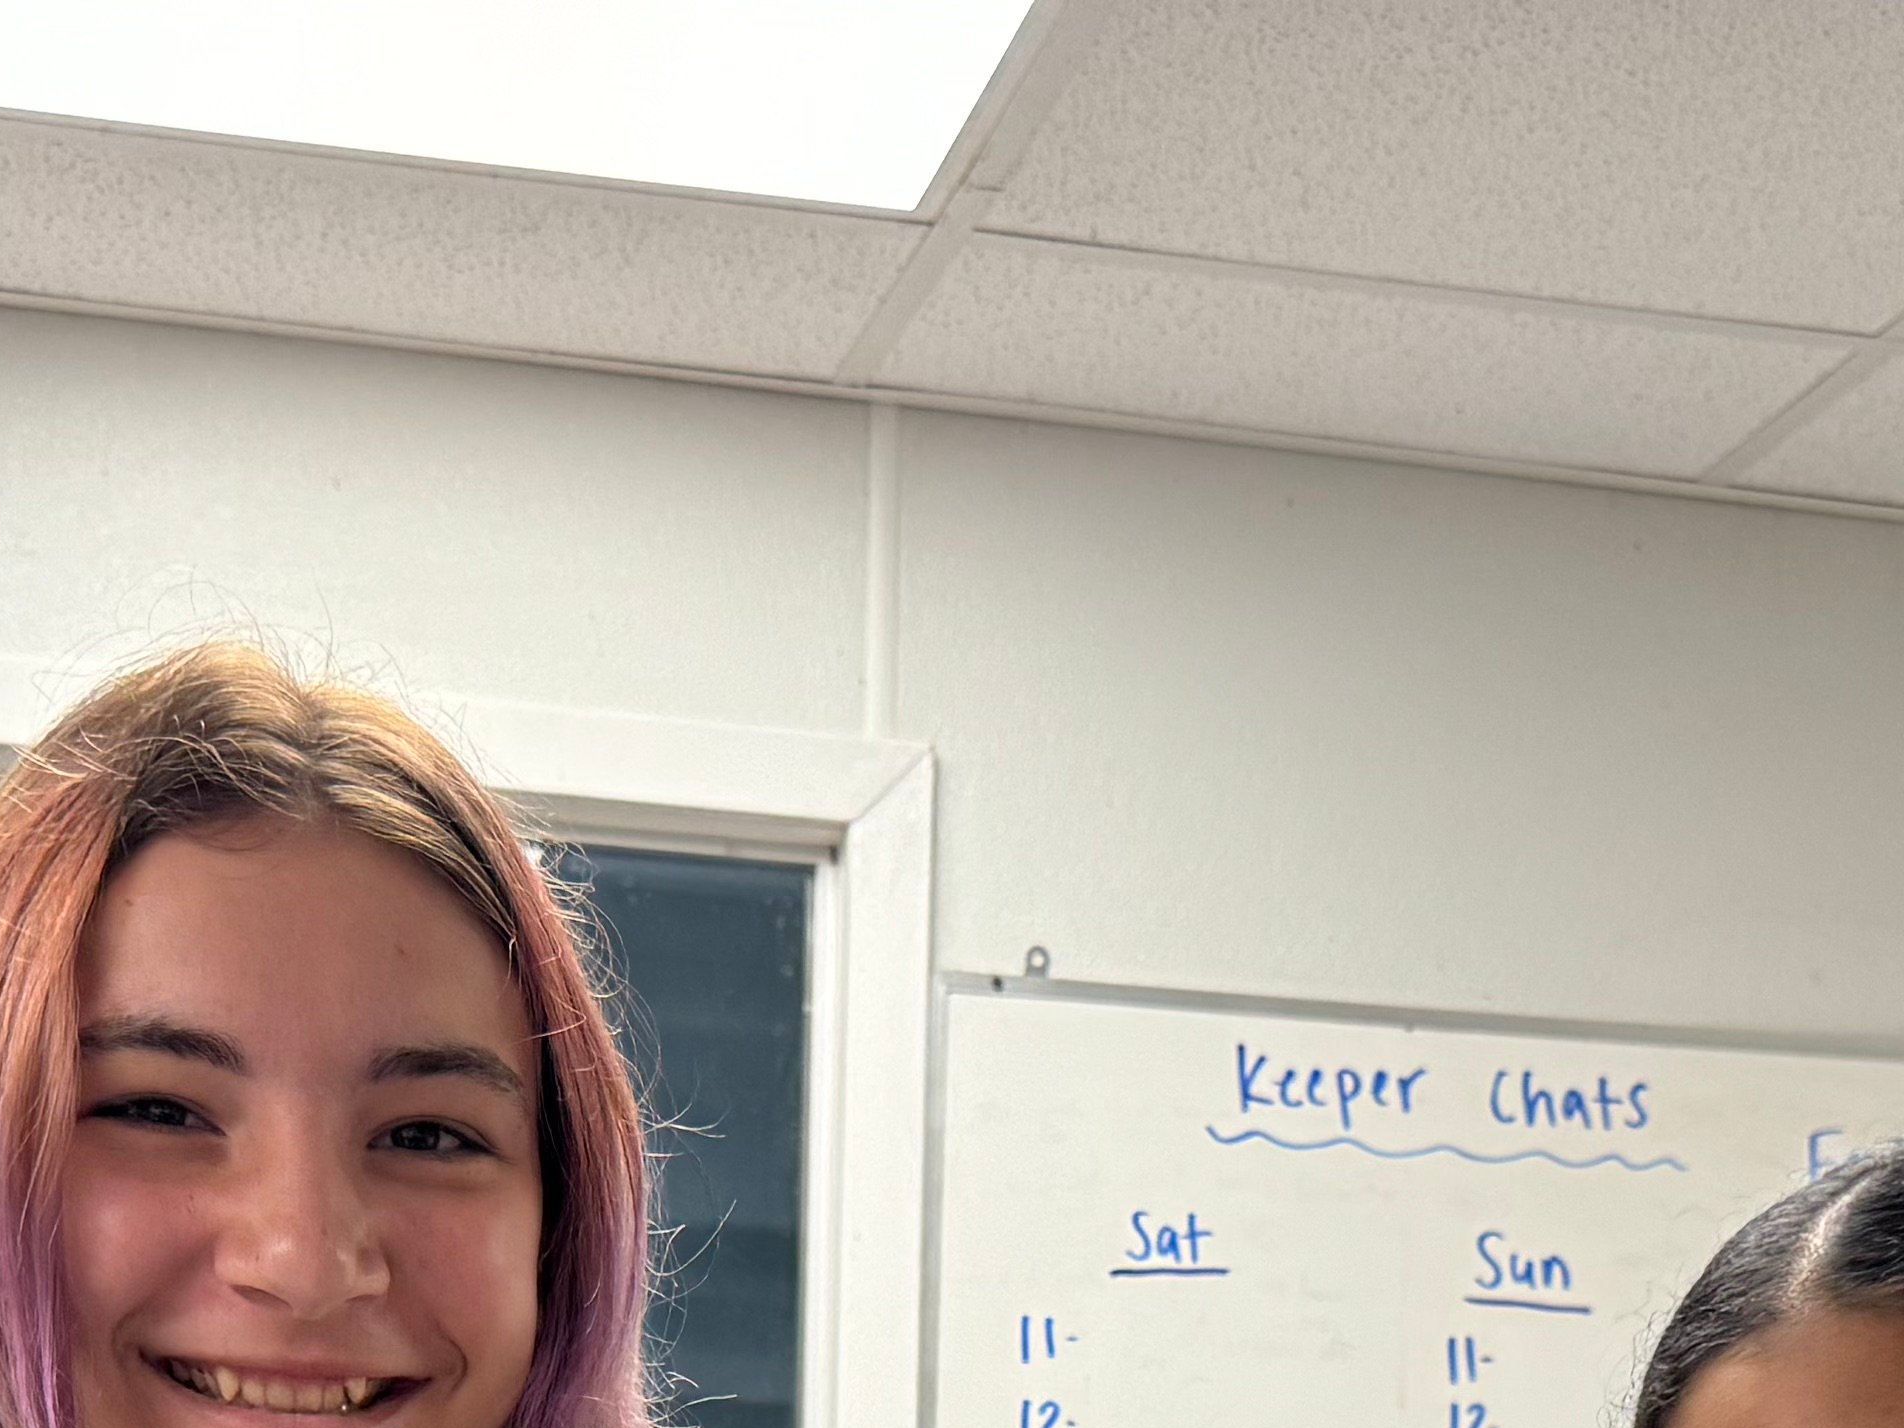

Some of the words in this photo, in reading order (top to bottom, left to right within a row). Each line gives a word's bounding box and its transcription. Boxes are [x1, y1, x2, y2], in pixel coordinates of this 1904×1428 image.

[1236, 1043, 1427, 1131] Keeper
[1489, 1070, 1649, 1132] Chats
[1125, 1210, 1214, 1265] Sat
[1474, 1230, 1572, 1291] Sun
